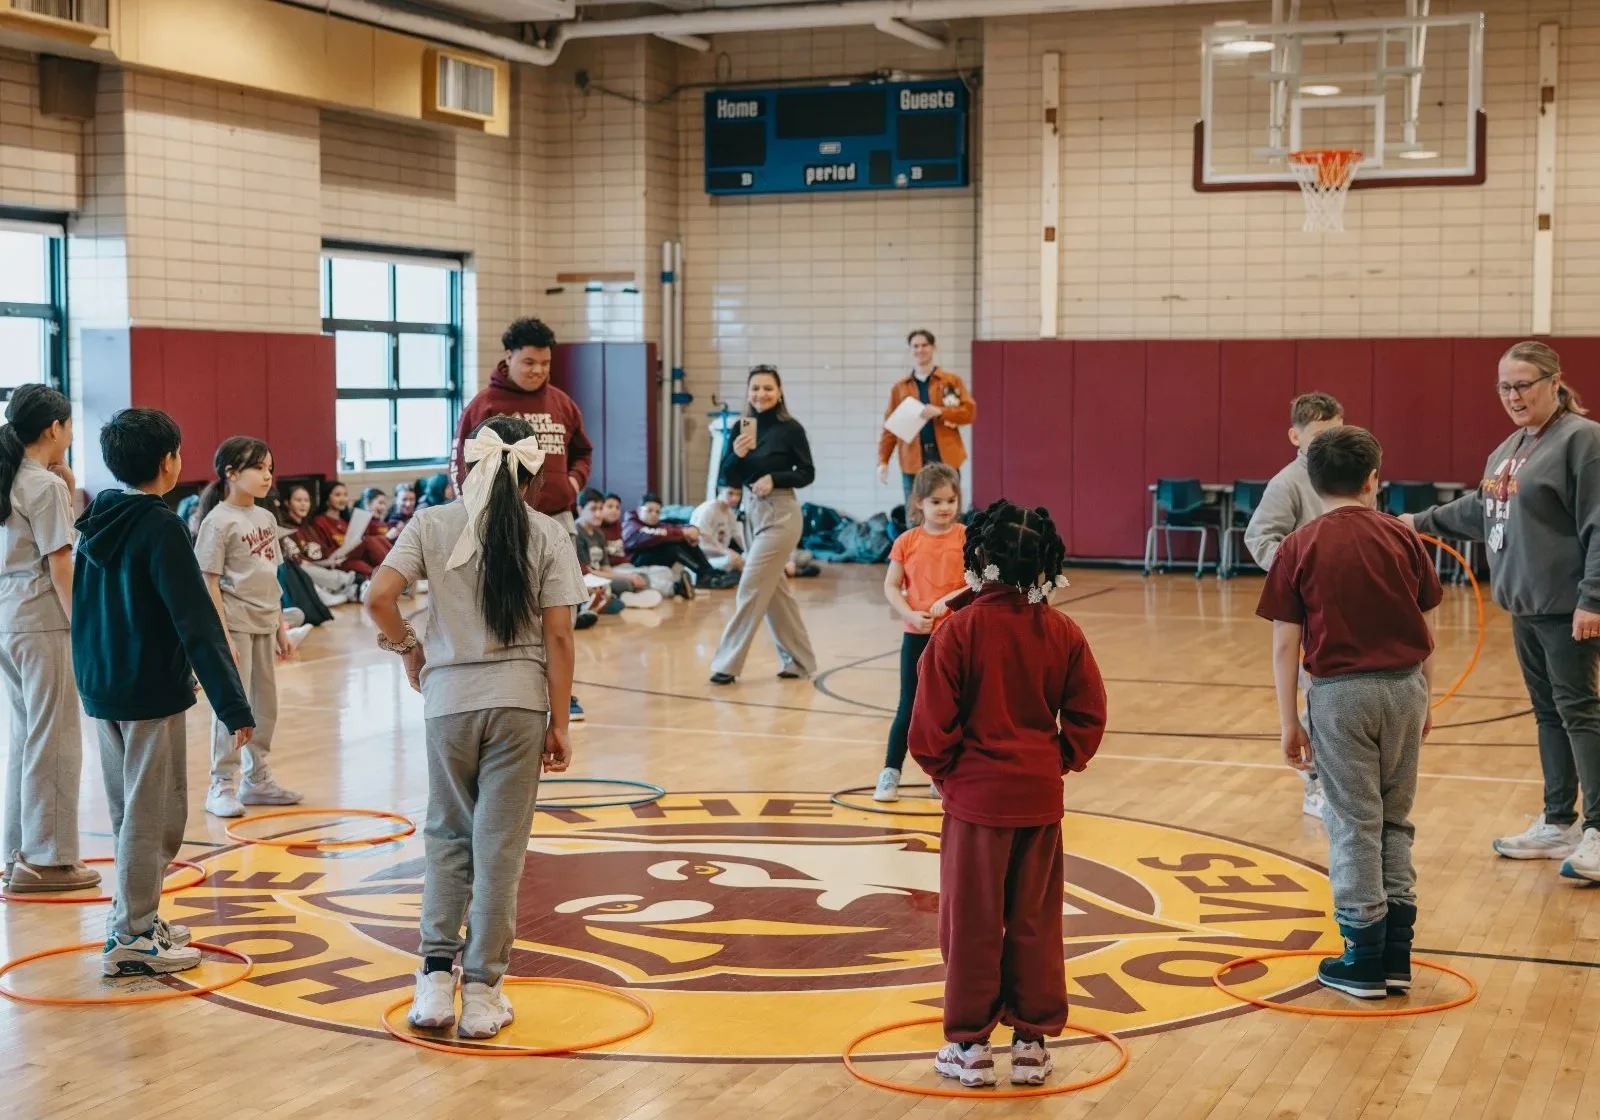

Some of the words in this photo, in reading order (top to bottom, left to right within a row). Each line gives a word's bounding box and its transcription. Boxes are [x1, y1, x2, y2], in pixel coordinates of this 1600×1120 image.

[717, 99, 758, 118] Home
[900, 89, 955, 110] Guests
[806, 163, 856, 185] period
[523, 413, 552, 424] POPE
[536, 434, 565, 445] LOBAL
[169, 869, 418, 1005] HOME
[534, 798, 834, 824] THE
